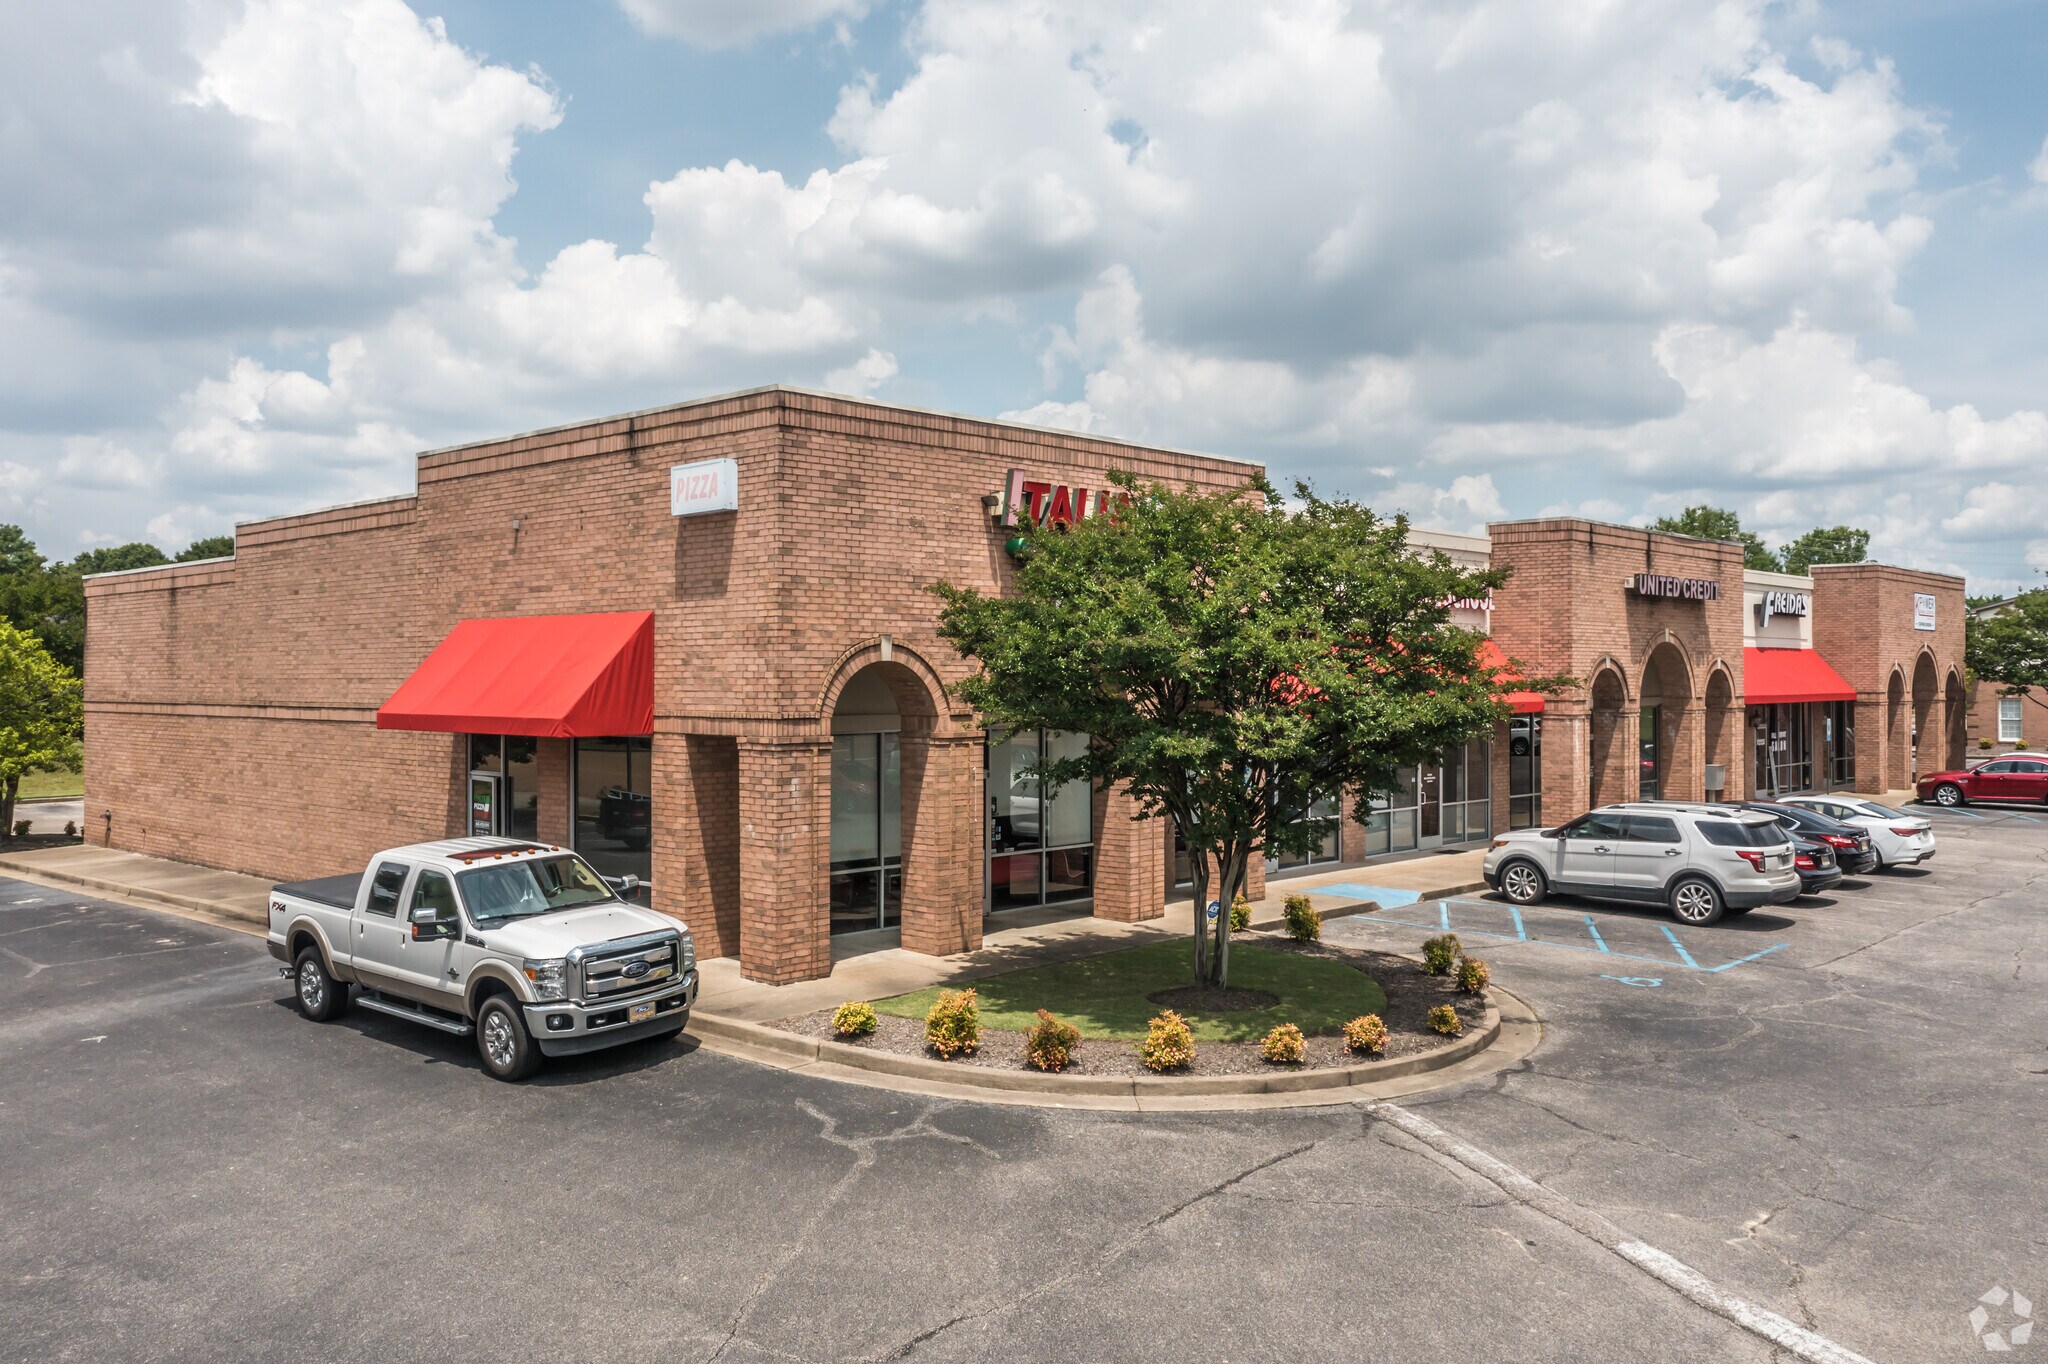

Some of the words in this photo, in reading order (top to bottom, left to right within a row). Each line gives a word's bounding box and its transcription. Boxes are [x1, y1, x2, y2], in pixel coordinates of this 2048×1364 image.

[676, 472, 718, 503] PIZZA
[1639, 573, 1680, 598] UNITED
[1683, 578, 1720, 600] CREDIT
[271, 901, 287, 912] FX4
[1208, 905, 1220, 914] ADT
[629, 964, 646, 975] Ford
